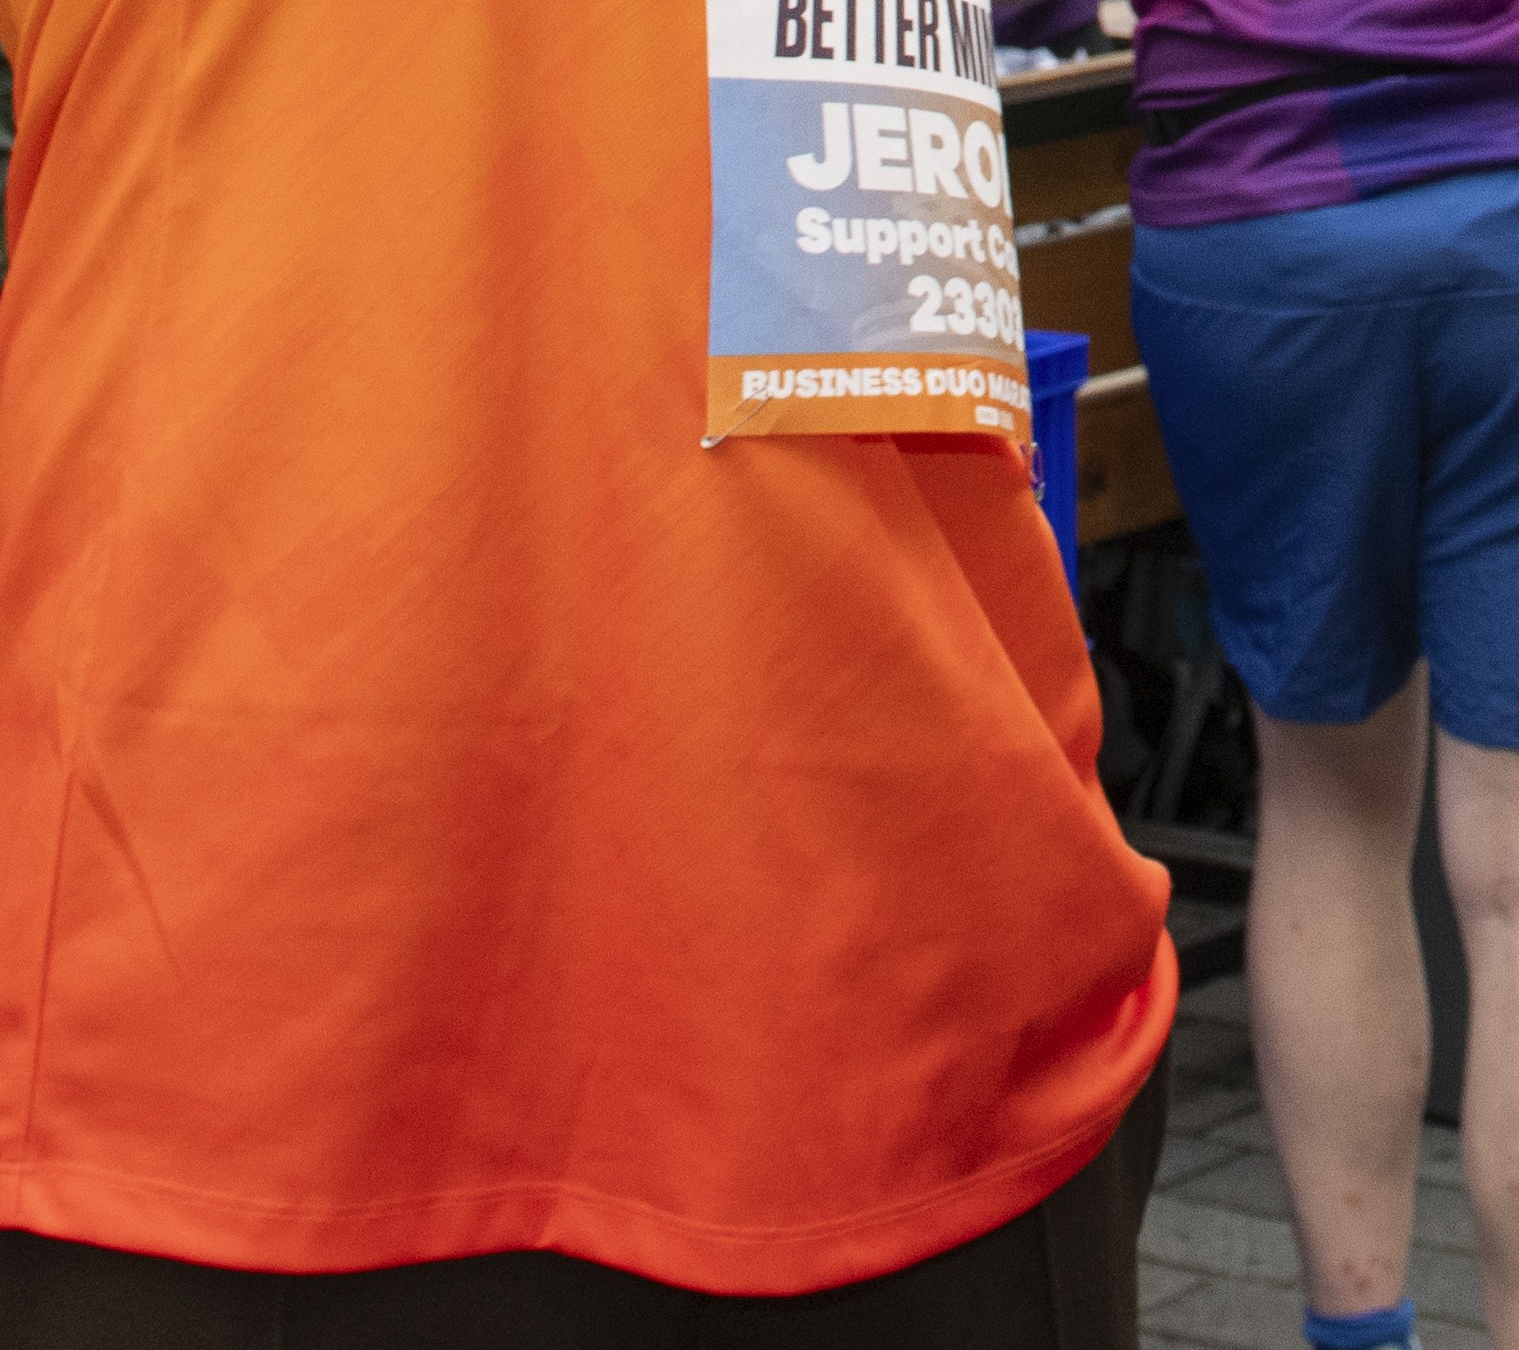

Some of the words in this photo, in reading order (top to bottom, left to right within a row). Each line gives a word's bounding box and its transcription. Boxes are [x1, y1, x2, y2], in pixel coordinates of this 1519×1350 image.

[786, 101, 1013, 220] JERO
[795, 206, 987, 266] Support
[741, 366, 924, 401] BUSINESS
[924, 366, 987, 397] DUO
